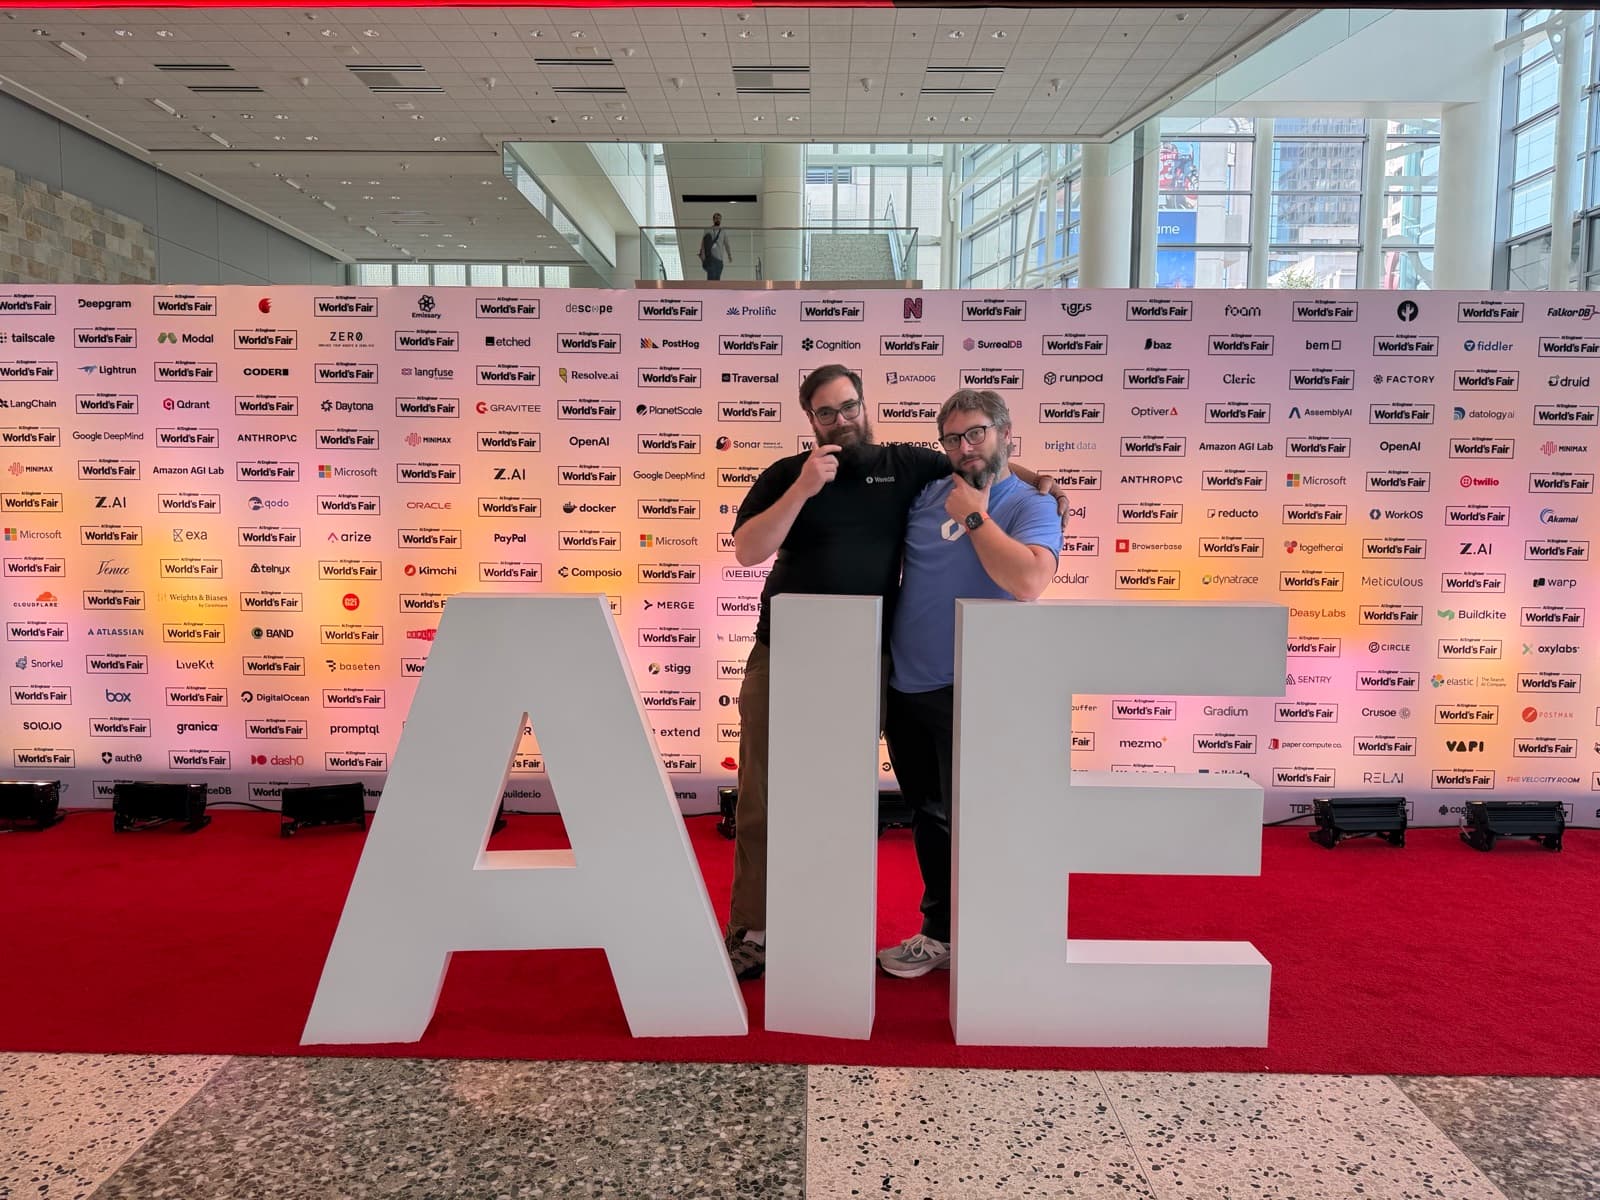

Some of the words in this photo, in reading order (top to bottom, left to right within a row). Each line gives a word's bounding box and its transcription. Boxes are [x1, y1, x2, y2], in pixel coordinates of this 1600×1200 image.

[78, 299, 131, 309] Deepgram
[158, 302, 195, 310] World's
[196, 302, 212, 311] Fair
[742, 306, 776, 315] Prolific
[805, 307, 841, 316] World's
[842, 307, 860, 316] Fair
[1225, 305, 1261, 316] foam
[1463, 308, 1501, 317] World's
[1501, 308, 1519, 317] Fair
[1547, 308, 1590, 317] FalkorDB
[12, 333, 55, 342] tailscale
[182, 334, 213, 343] Modal
[496, 337, 530, 346] etched
[663, 340, 699, 349] PostHog
[816, 340, 860, 351] Cognition
[978, 340, 1022, 348] SurrealDB
[1153, 339, 1171, 349] baz
[1306, 340, 1329, 350] bem
[1478, 341, 1513, 351] fiddler
[100, 366, 136, 375] Lightrun
[415, 367, 453, 377] langfuse
[572, 371, 618, 379] Resolve.ai
[732, 373, 779, 383] Traversal
[1060, 374, 1103, 383] runpod
[1223, 374, 1255, 384] Cleric
[1560, 376, 1589, 387] druid
[10, 400, 56, 409] LangChain
[177, 400, 210, 408] Qdrant
[336, 401, 373, 411] Daytona
[649, 406, 702, 415] PlanetScale
[1131, 407, 1169, 417] Optiver
[1305, 409, 1352, 417] AssemblyAI
[73, 431, 102, 441] Google
[104, 432, 144, 441] DeepMind
[569, 437, 609, 448] OpenAI
[1045, 441, 1075, 452] bright
[1077, 441, 1096, 450] data
[1380, 441, 1420, 452] OpenAI
[153, 466, 188, 474] Amazon
[335, 467, 377, 476] Microsoft
[494, 468, 525, 480] Z.AI
[633, 471, 663, 481] Google
[665, 472, 705, 480] DeepMind
[1303, 476, 1346, 485] Microsoft
[1473, 478, 1499, 486] twilio
[95, 497, 126, 508] Z.AI
[265, 499, 288, 508] qodo
[483, 504, 519, 512] World's
[519, 504, 537, 512] Fair
[579, 504, 616, 512] docker
[1068, 507, 1086, 518] o4j
[1218, 509, 1258, 518] reducto
[1385, 511, 1423, 519] WorkOS
[1547, 515, 1578, 524] Akamai
[20, 530, 62, 539] Microsoft
[186, 531, 207, 540] exa
[341, 531, 371, 542] arize
[494, 534, 526, 544] PayPal
[656, 537, 698, 545] Microsoft
[1204, 544, 1240, 552] World's
[1241, 544, 1259, 552] Fair
[1300, 543, 1343, 554] together.ai
[1460, 543, 1491, 554] Z.AI
[97, 560, 129, 575] Venice
[261, 565, 290, 574] telnyx
[419, 566, 456, 575] Kimchi
[572, 568, 622, 578] Composio
[1052, 574, 1089, 584] odular
[1213, 575, 1258, 584] dynatrace
[1361, 576, 1423, 587] Meticulous
[1548, 579, 1576, 588] warp
[1290, 608, 1321, 619] Deasy
[1322, 609, 1346, 617] Labs
[1459, 610, 1506, 619] Buildkite
[1526, 613, 1562, 622] World's
[1562, 613, 1580, 622] Fair
[11, 628, 46, 636] World's
[47, 628, 64, 636] Fair
[97, 628, 143, 636] ATLASSIAN
[266, 629, 293, 638] BAND
[643, 634, 678, 642] World's
[679, 634, 696, 642] Fair
[31, 660, 63, 668] Snorkel
[665, 664, 691, 674] stigg
[106, 689, 131, 702] box
[257, 694, 309, 702] DigitalOcean
[1204, 706, 1248, 716] Gradium
[1362, 708, 1396, 717] Crusoe
[177, 721, 218, 734] granica
[330, 725, 379, 735] promptql
[661, 728, 700, 736] extend
[1120, 739, 1162, 748] mezmo
[1519, 744, 1555, 752] World's
[1556, 744, 1572, 753] Fair
[174, 756, 209, 764] World's
[209, 756, 226, 765] Fair
[1277, 773, 1311, 782] World's
[1312, 774, 1331, 782] Fair
[300, 593, 1288, 1047] AIE
